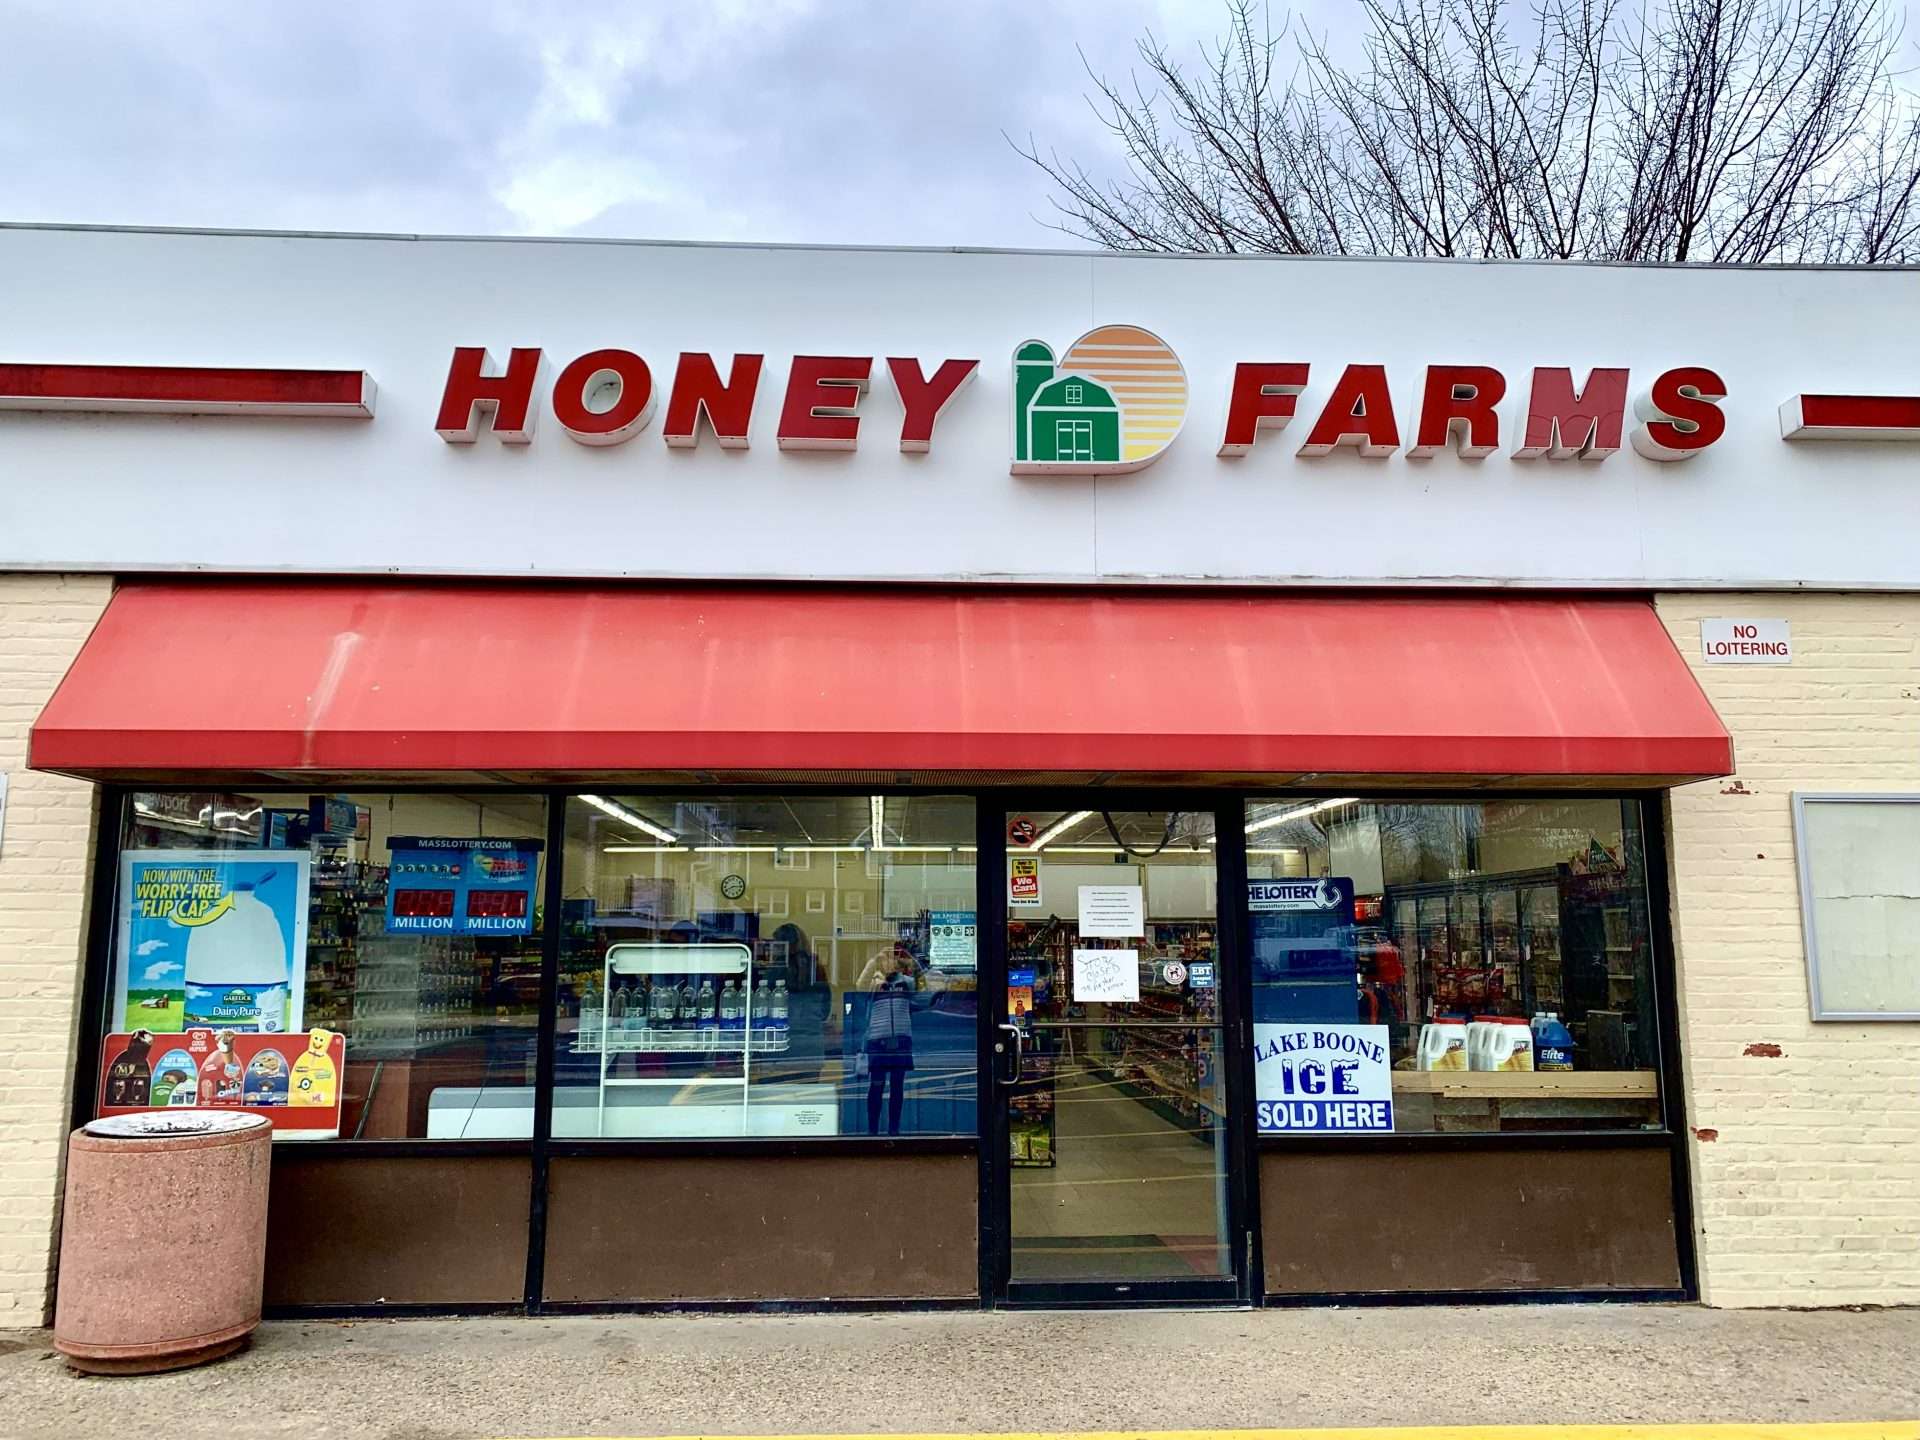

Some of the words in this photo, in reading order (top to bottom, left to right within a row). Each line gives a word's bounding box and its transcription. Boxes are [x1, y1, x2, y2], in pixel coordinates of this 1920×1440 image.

[435, 346, 980, 450] HONEY
[1220, 362, 1728, 456] FARMS
[1733, 625, 1758, 639] NO
[1706, 642, 1788, 656] LOITERING
[418, 839, 512, 849] MASSLOTTERY.COM
[143, 869, 167, 882] NOW
[168, 869, 195, 882] WITH
[196, 869, 216, 882] THE
[1015, 877, 1033, 886] We
[136, 883, 223, 899] WORRY-FREE
[1012, 882, 1037, 893] Card
[142, 899, 174, 917] FLIP
[177, 899, 209, 917] CAP
[394, 918, 453, 929] MILLION
[468, 918, 527, 929] MILLION
[1191, 966, 1211, 976] EBT
[1254, 1031, 1308, 1063] LAKE
[1312, 1031, 1385, 1064] BOONE
[1540, 1048, 1565, 1060] Elite
[1281, 1058, 1360, 1095] ICE
[1257, 1102, 1318, 1128] SOLD
[1324, 1102, 1388, 1128] HERE
